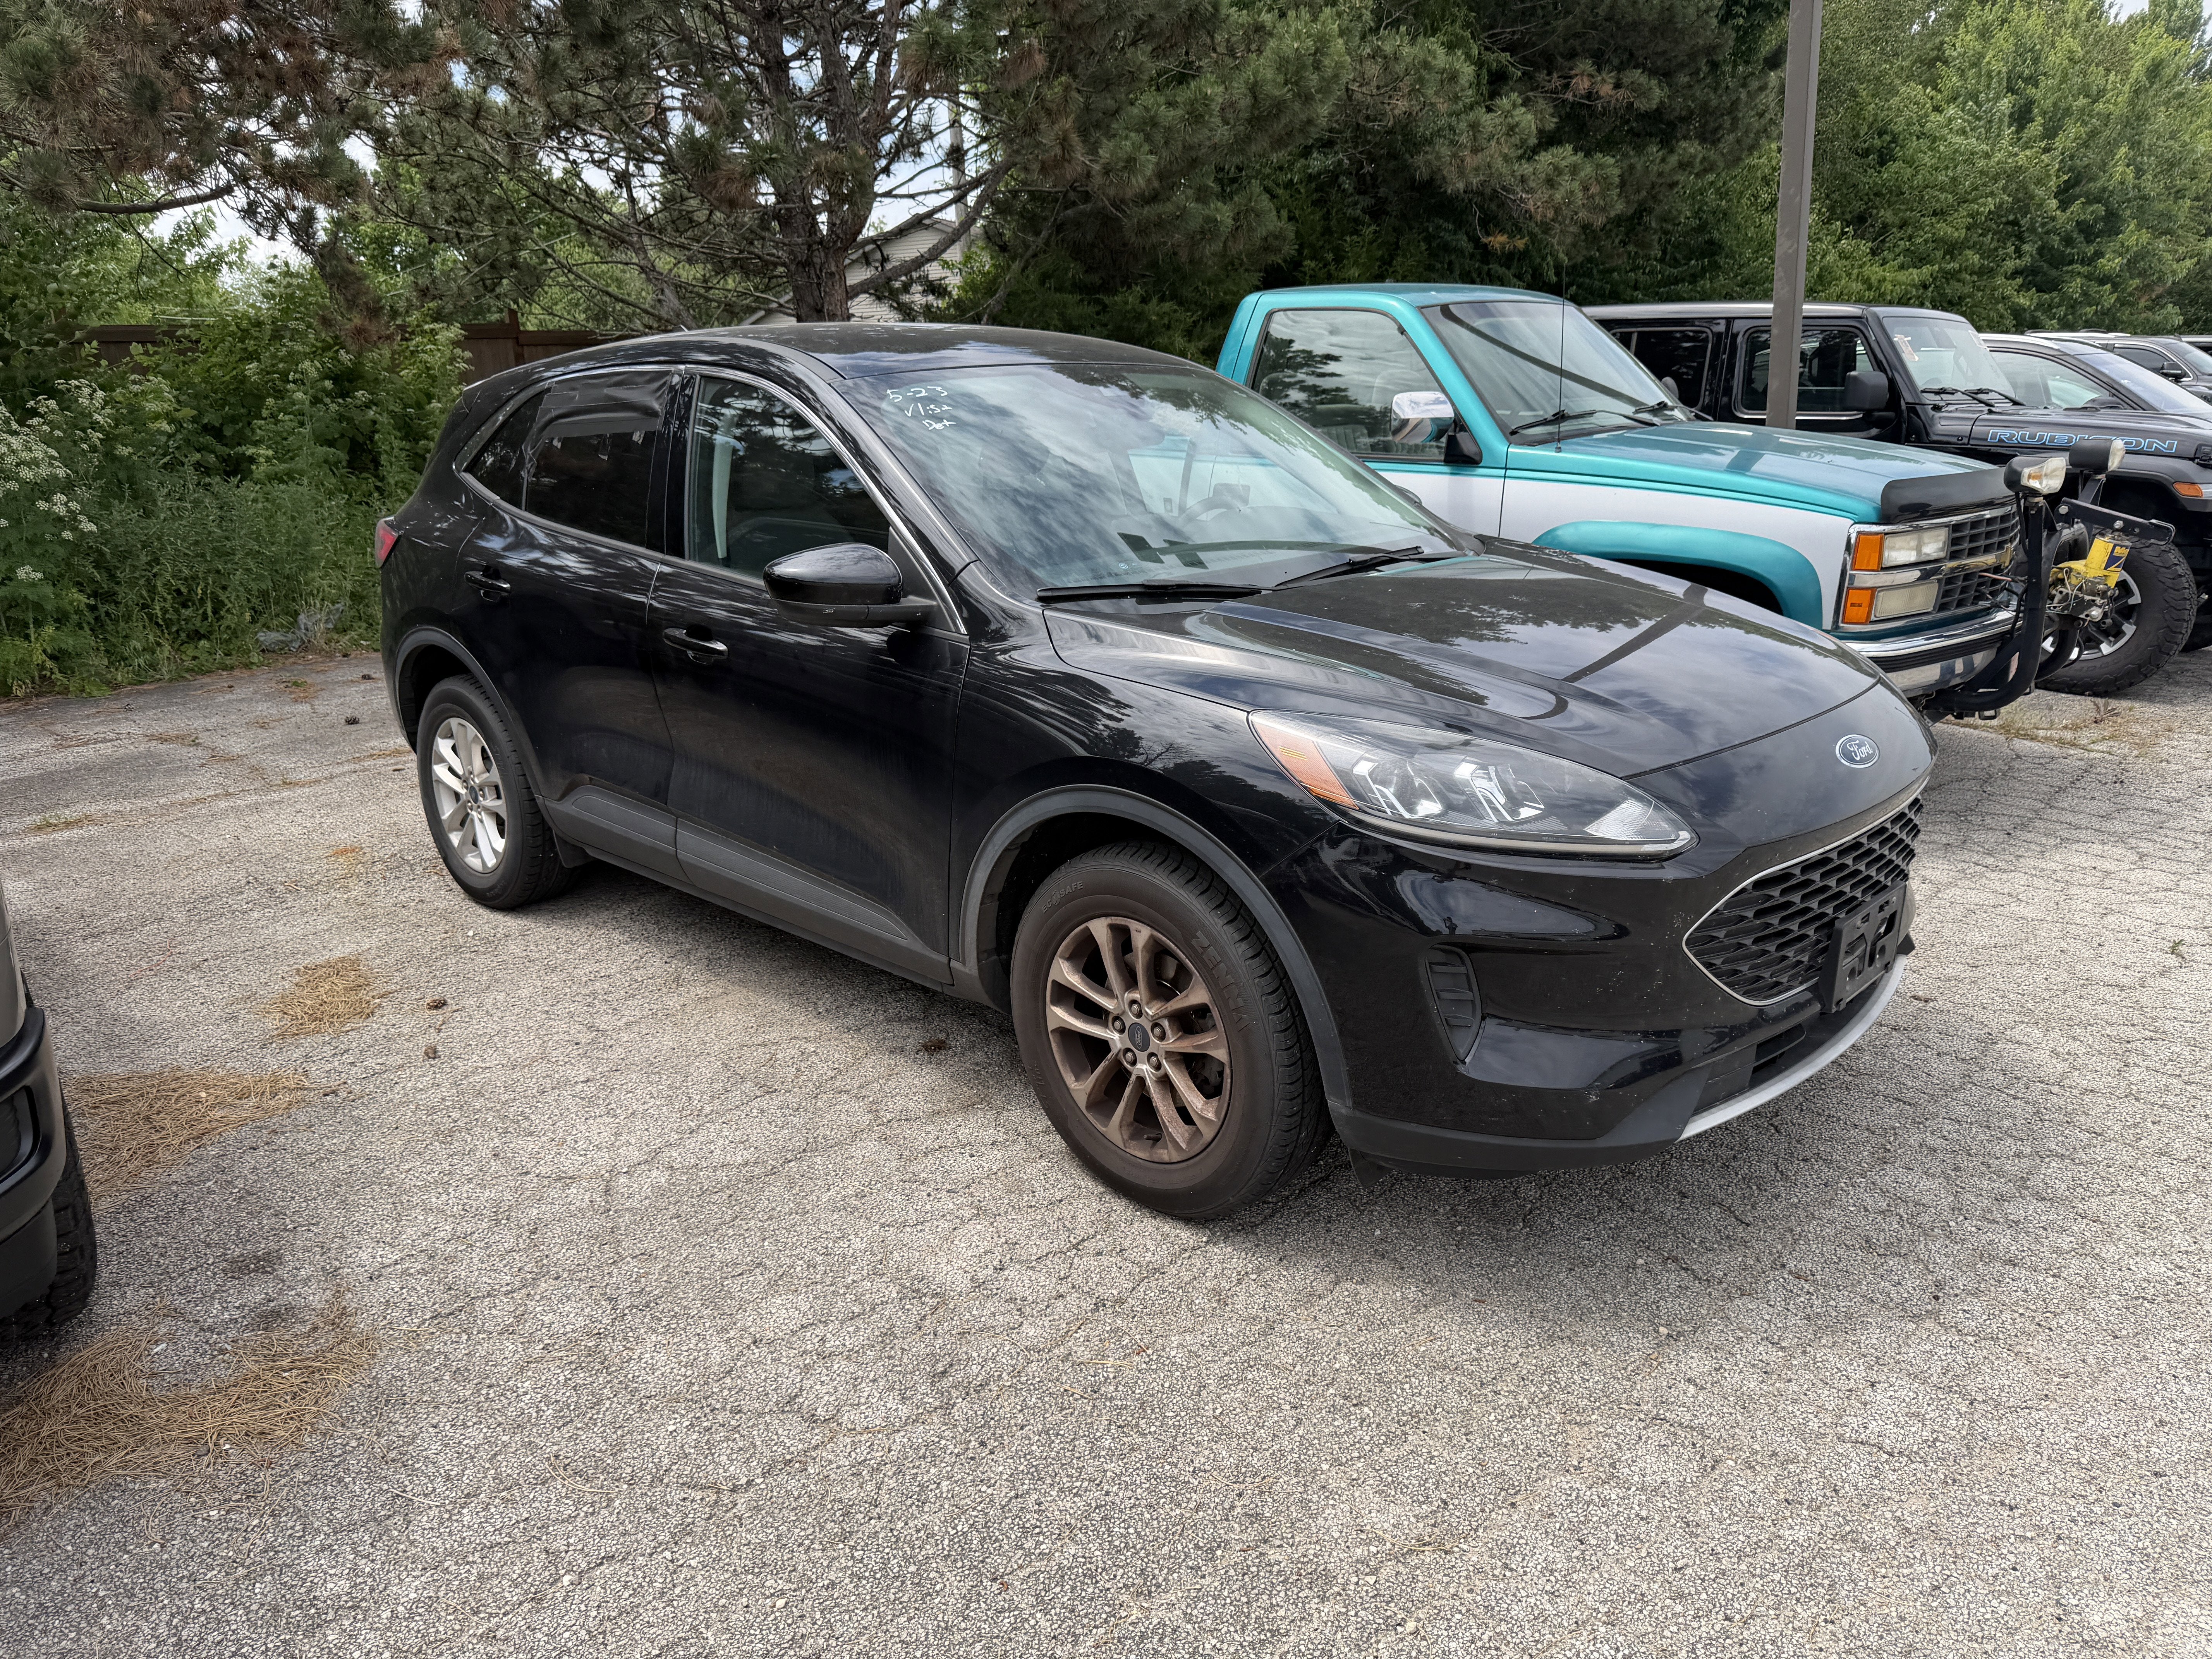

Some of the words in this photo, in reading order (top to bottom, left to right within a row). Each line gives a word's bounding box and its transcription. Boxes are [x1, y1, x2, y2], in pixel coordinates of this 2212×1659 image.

[886, 386, 948, 402] 5-23
[1987, 429, 2177, 453] RUBON
[1847, 740, 1873, 760] Ford
